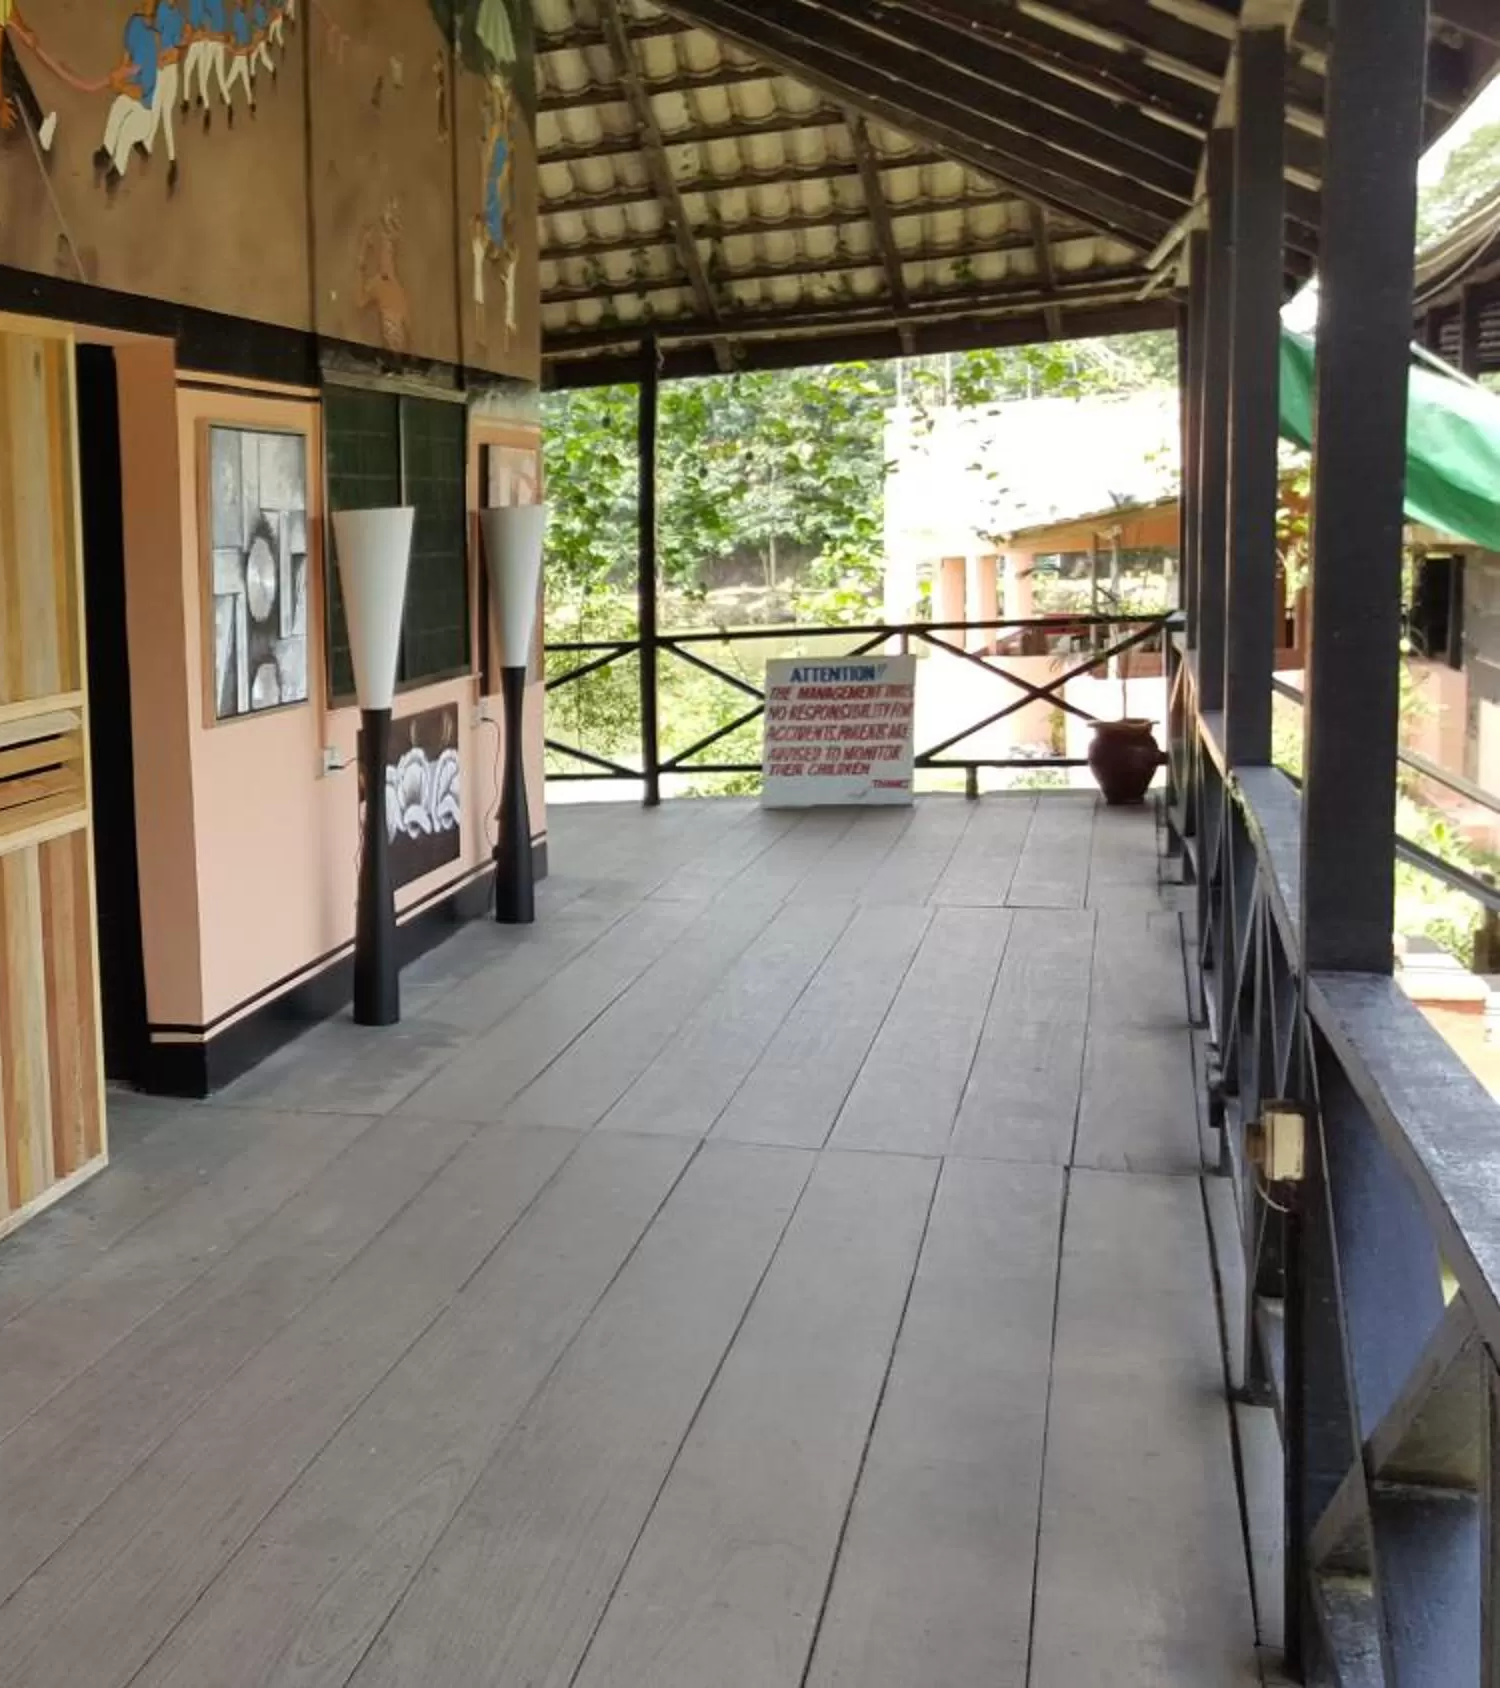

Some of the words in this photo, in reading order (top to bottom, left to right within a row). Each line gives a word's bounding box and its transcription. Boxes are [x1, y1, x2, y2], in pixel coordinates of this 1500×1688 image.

[769, 685, 792, 700] THE
[796, 684, 884, 699] MANAGEMENT
[768, 704, 787, 720] NO
[825, 745, 842, 762] TO
[842, 745, 903, 761] MONITOR
[807, 762, 871, 776] CHILDREN
